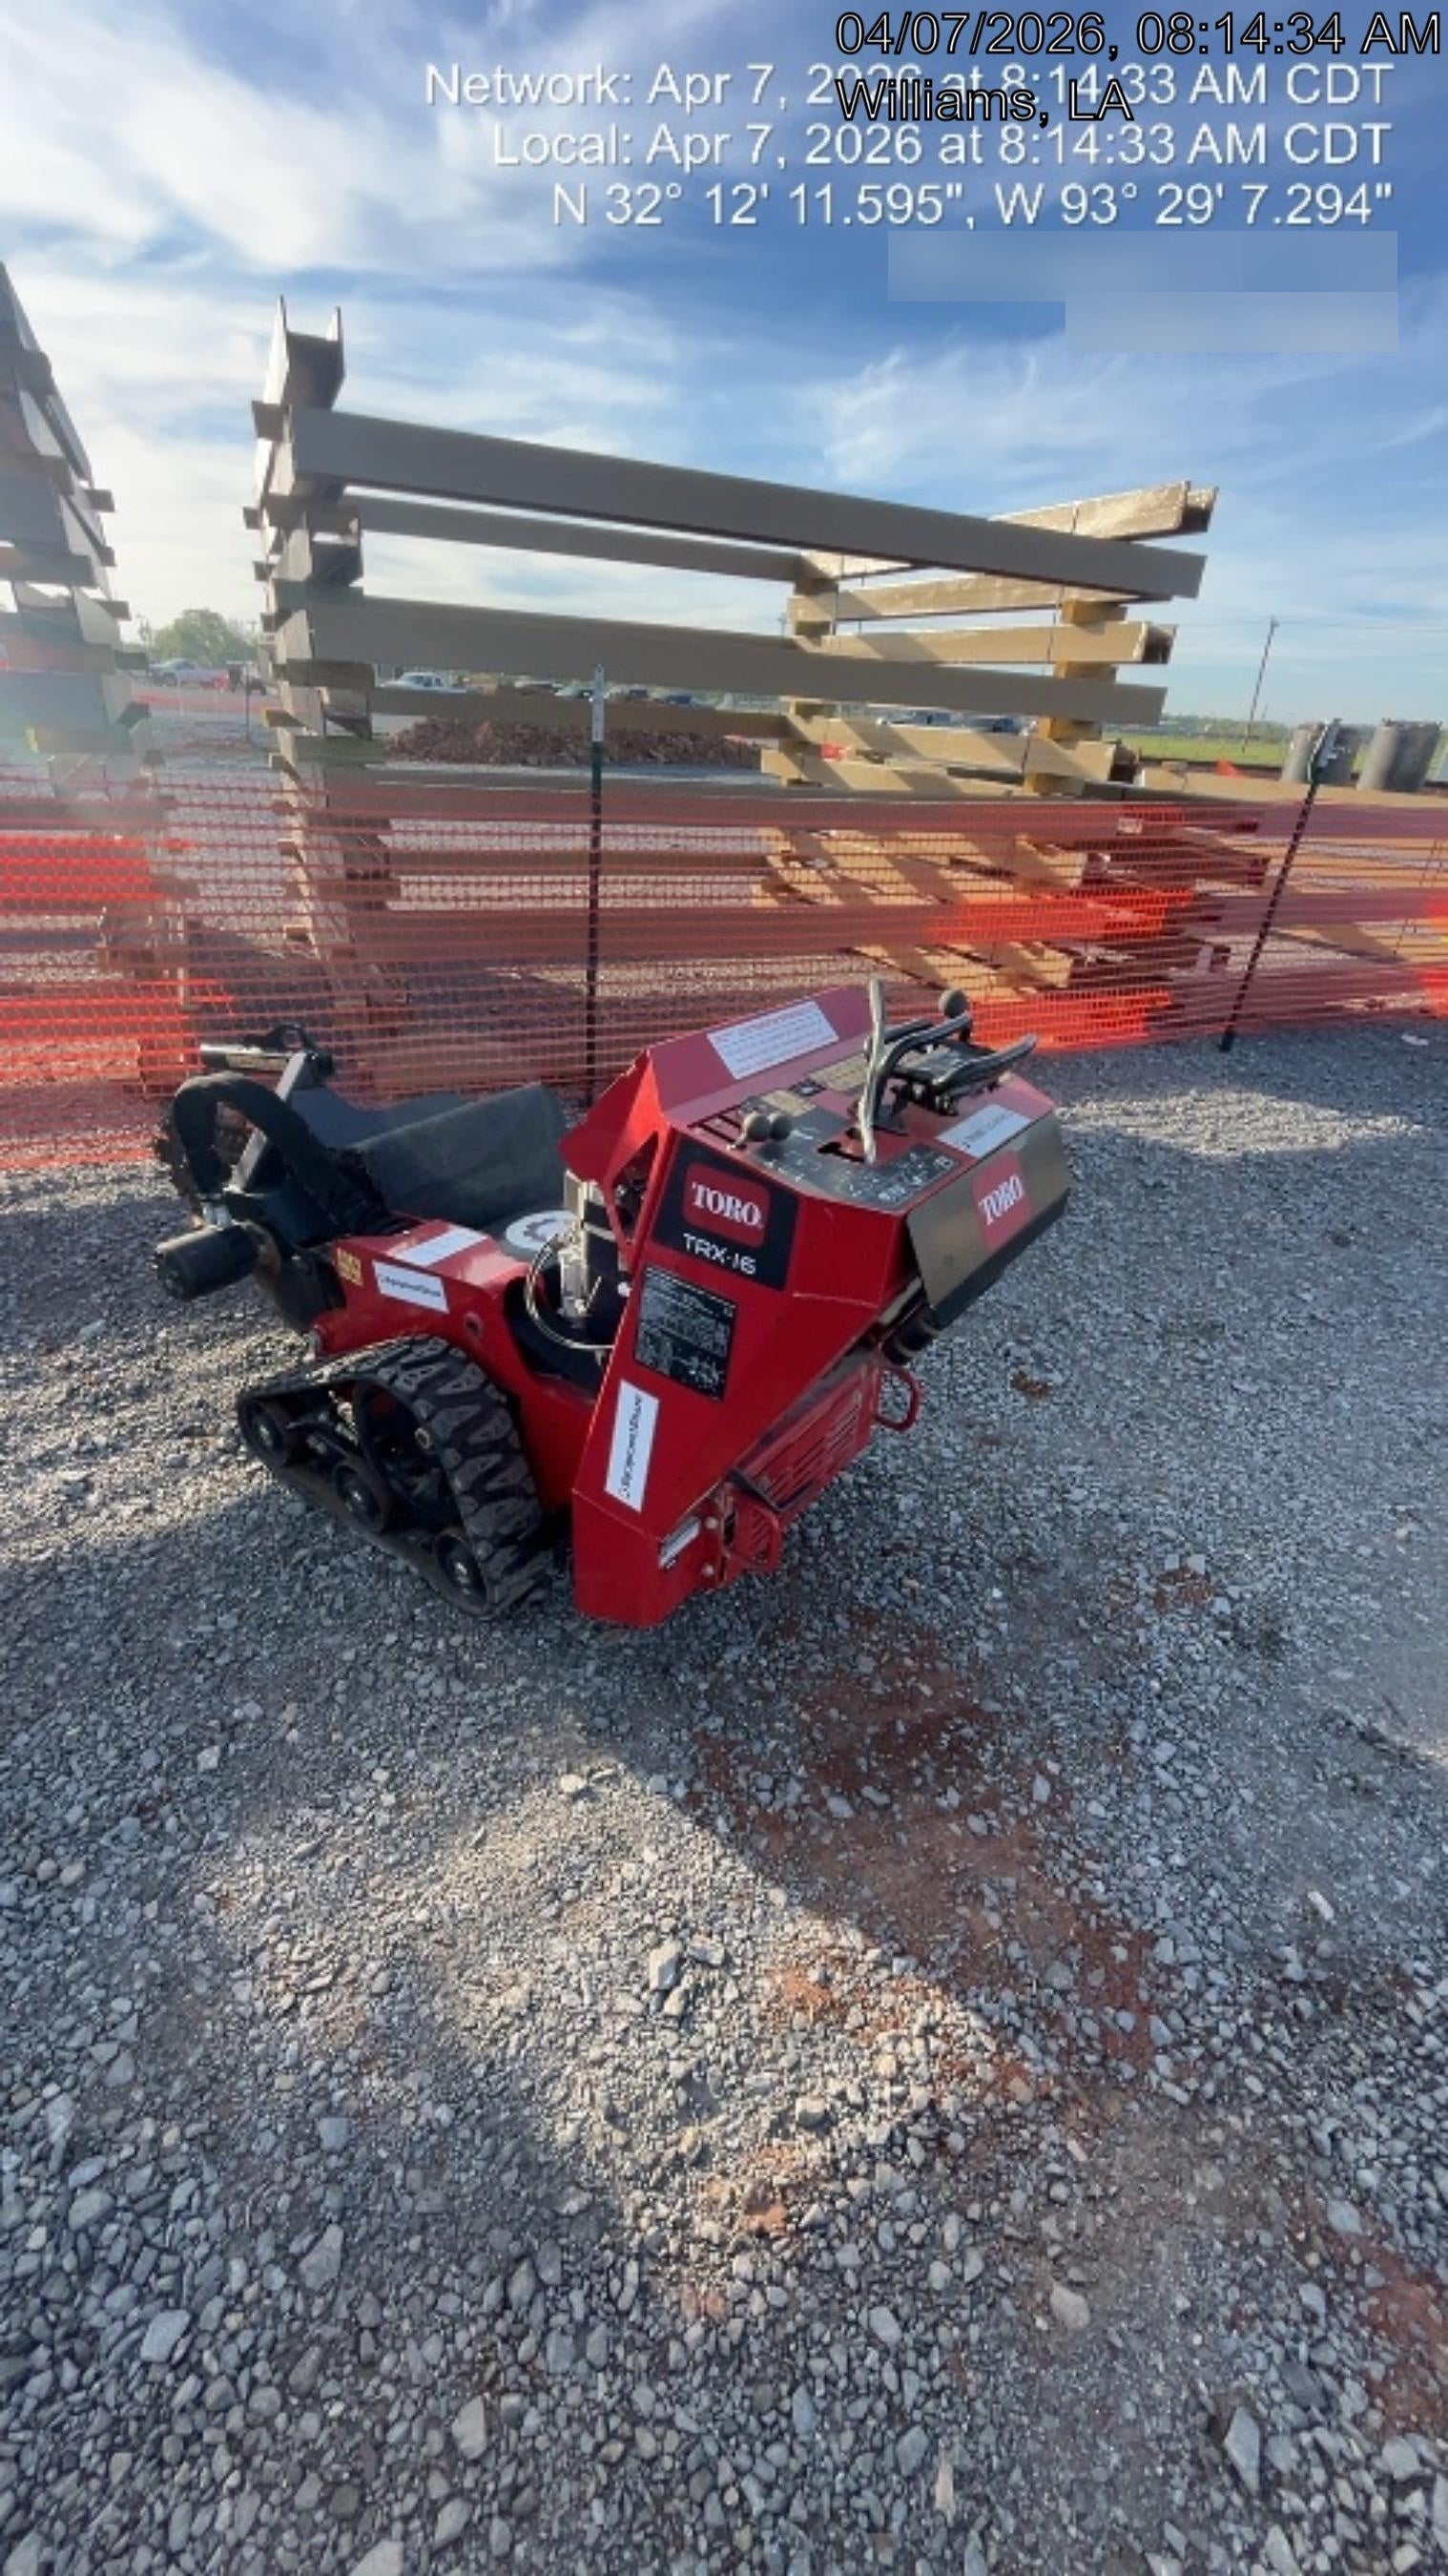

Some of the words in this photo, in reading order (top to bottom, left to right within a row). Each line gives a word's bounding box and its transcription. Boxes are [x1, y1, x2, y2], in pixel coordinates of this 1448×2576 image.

[691, 1181, 763, 1228] TORO
[978, 1174, 1024, 1226] TORO
[683, 1232, 756, 1275] TRX-16
